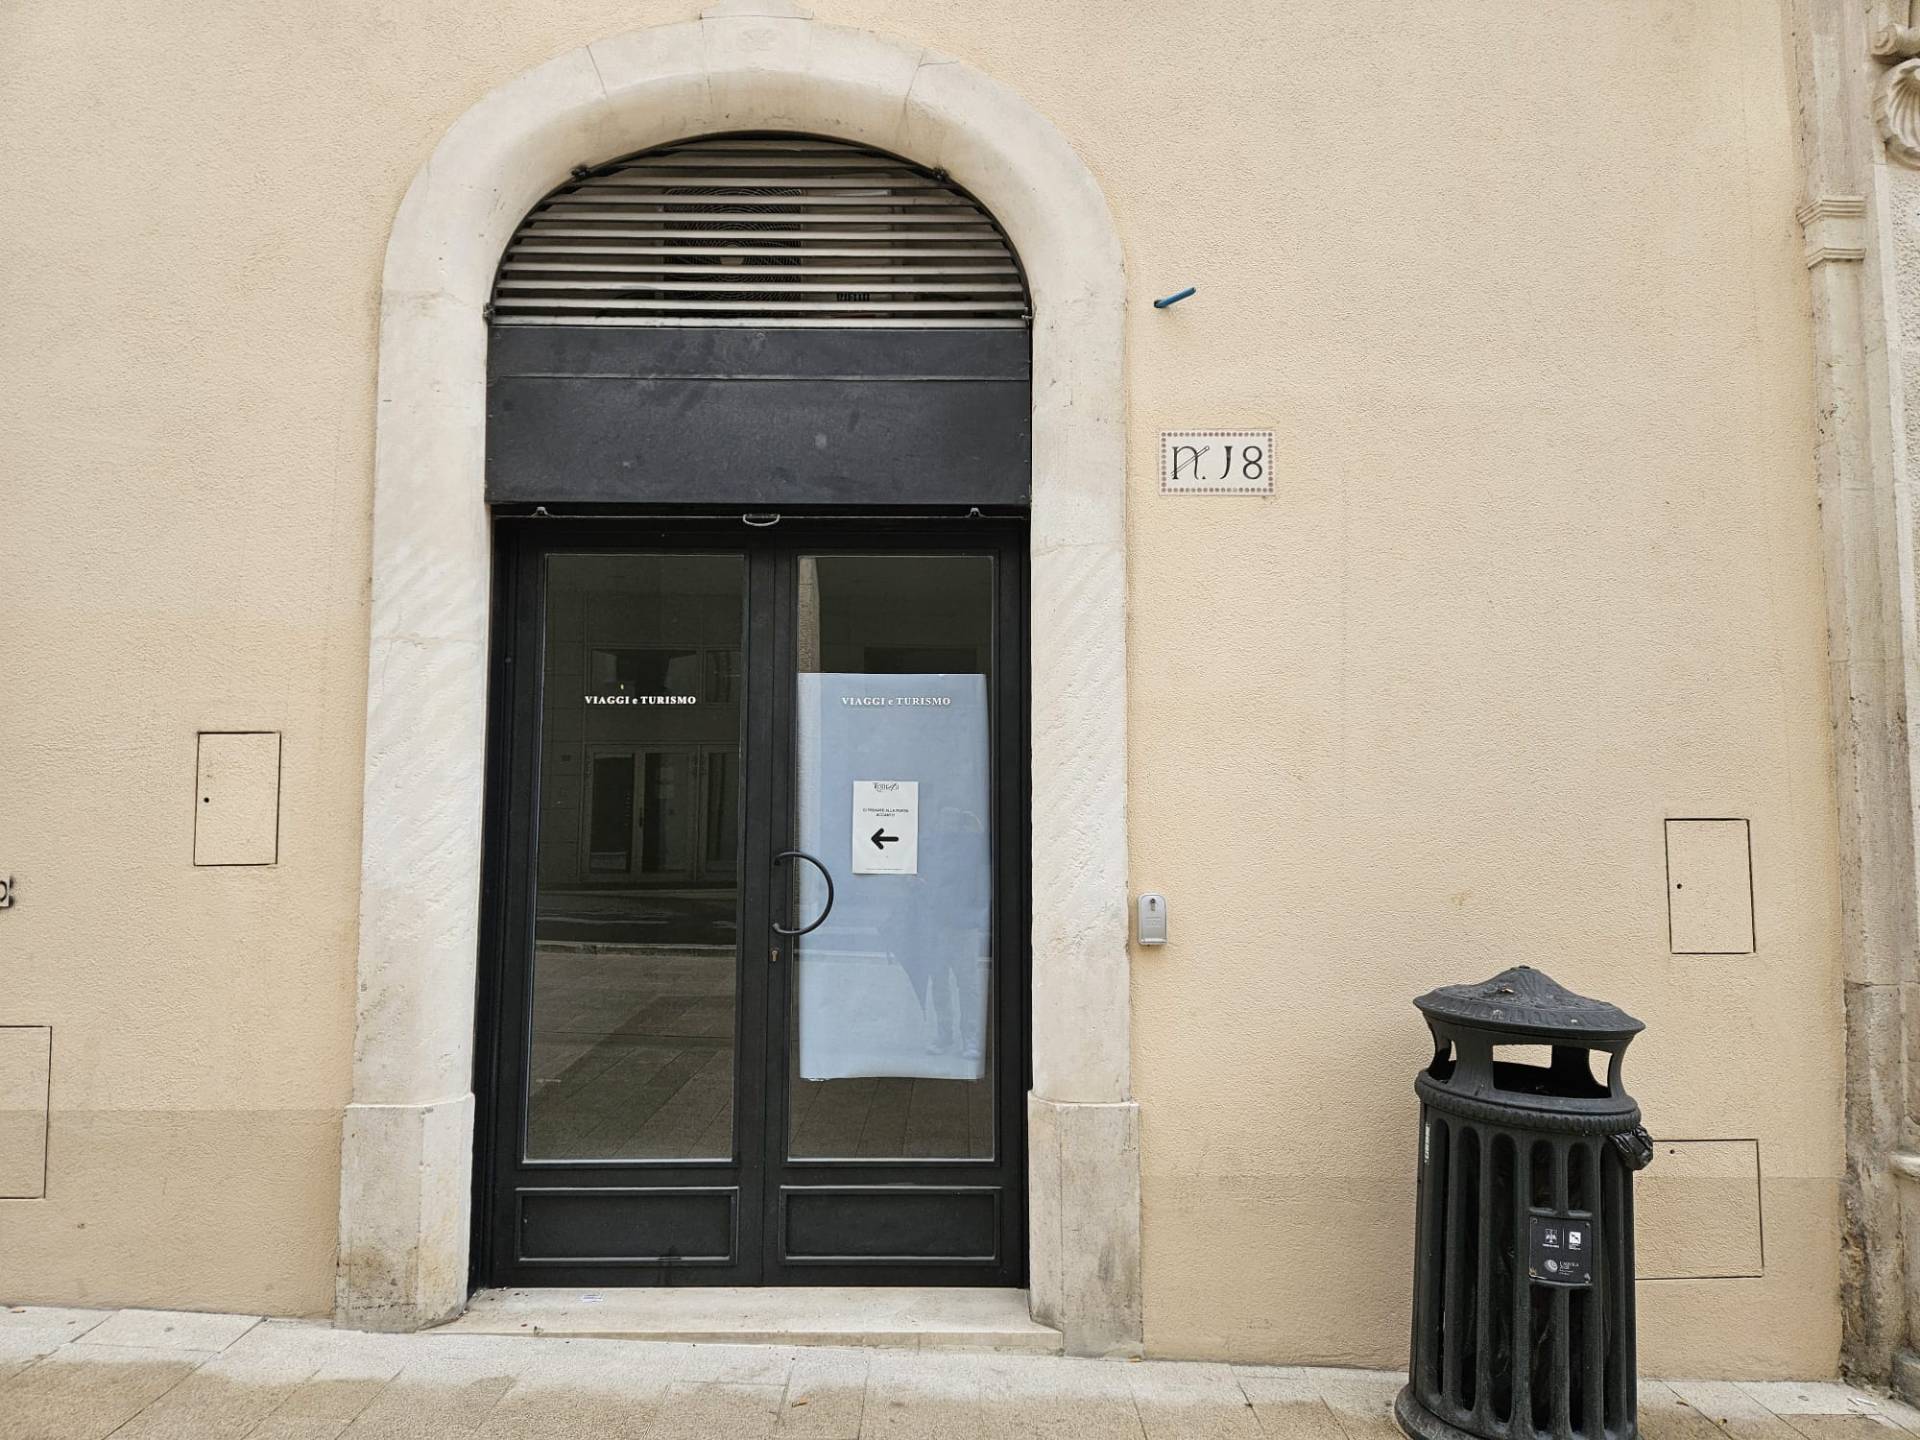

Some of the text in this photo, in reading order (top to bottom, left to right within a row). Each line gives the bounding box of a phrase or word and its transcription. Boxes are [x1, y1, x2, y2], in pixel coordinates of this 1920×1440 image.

[584, 695, 697, 705] VIAGGI e TURISMO
[842, 697, 885, 706] VIAGGI
[895, 697, 951, 706] TURISMO
